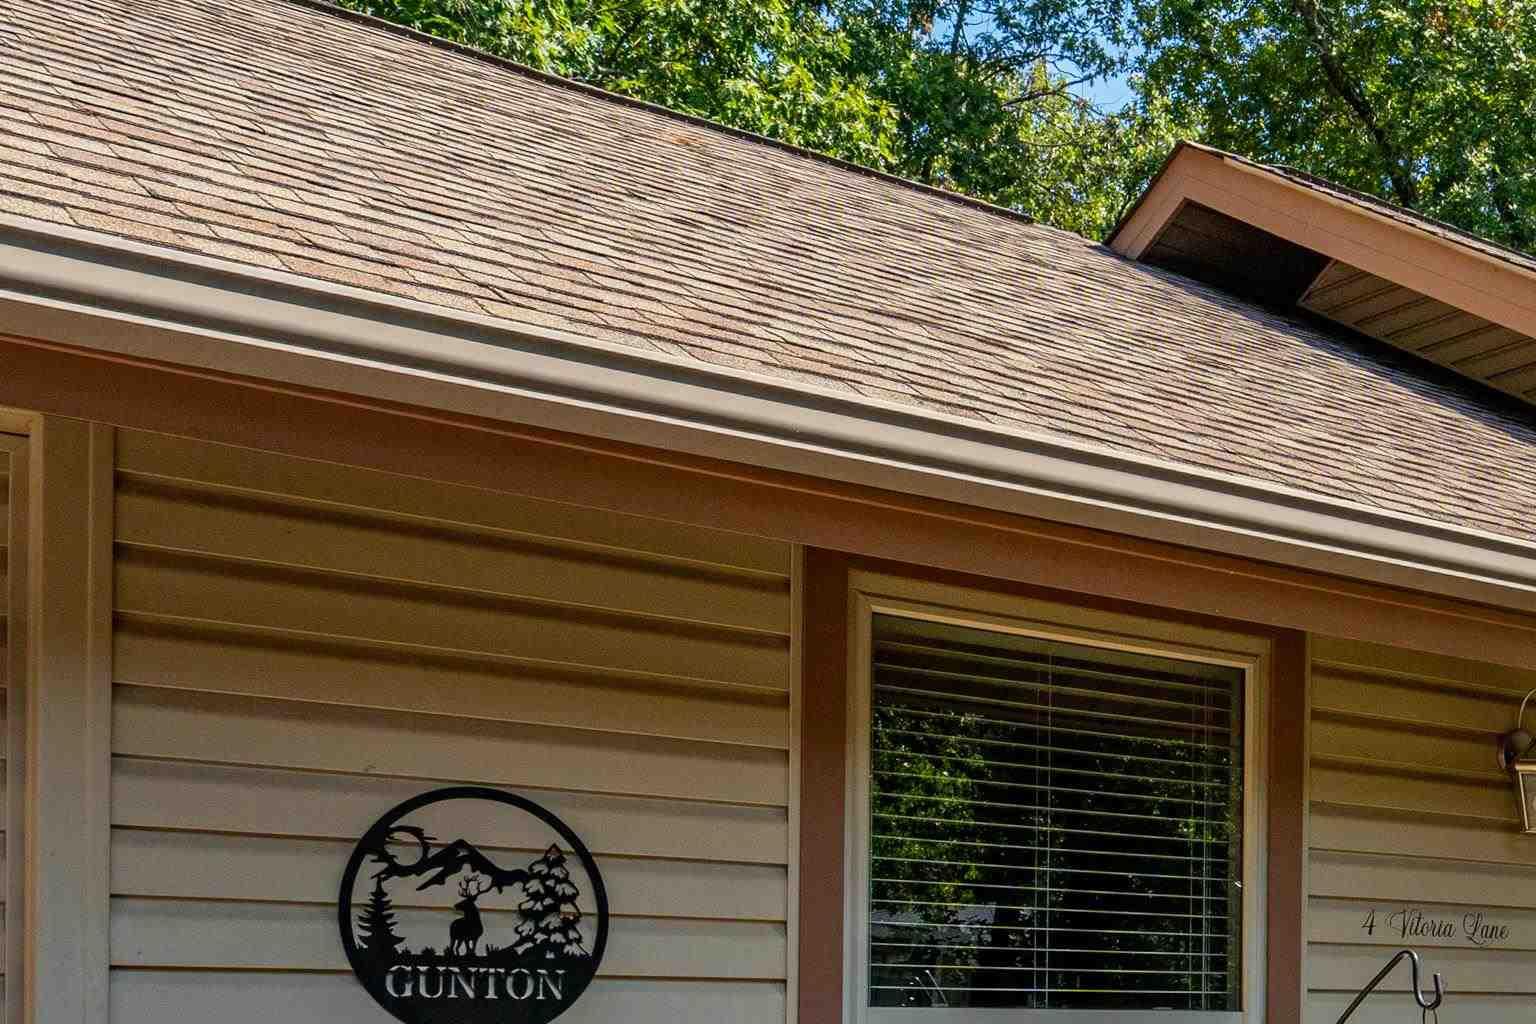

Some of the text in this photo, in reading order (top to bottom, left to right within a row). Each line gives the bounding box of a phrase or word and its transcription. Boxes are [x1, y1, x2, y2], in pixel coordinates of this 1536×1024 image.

[1362, 909, 1510, 945] 4 Vitoria Lane
[385, 965, 566, 1000] GUNTON
